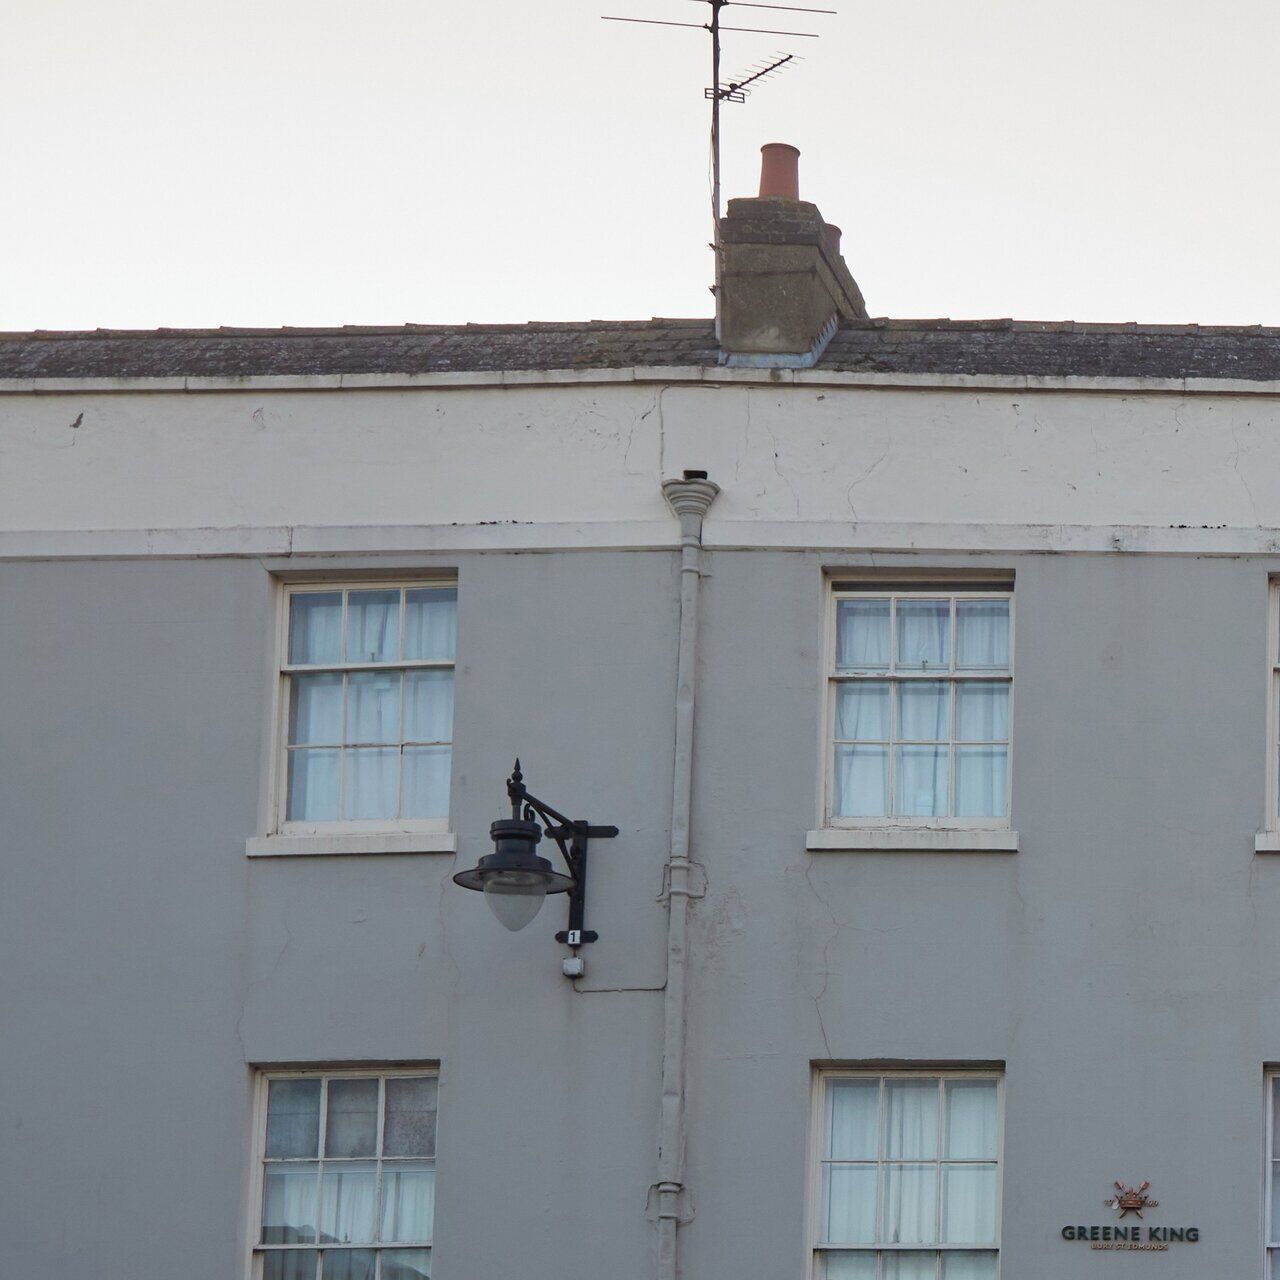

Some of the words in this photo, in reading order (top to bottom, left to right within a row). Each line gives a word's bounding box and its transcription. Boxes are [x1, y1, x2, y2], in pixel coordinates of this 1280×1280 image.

[1061, 1226, 1140, 1241] GREENE
[1149, 1227, 1199, 1242] KING
[1091, 1242, 1113, 1250] BURY
[1128, 1242, 1168, 1251] EDMUNDS
